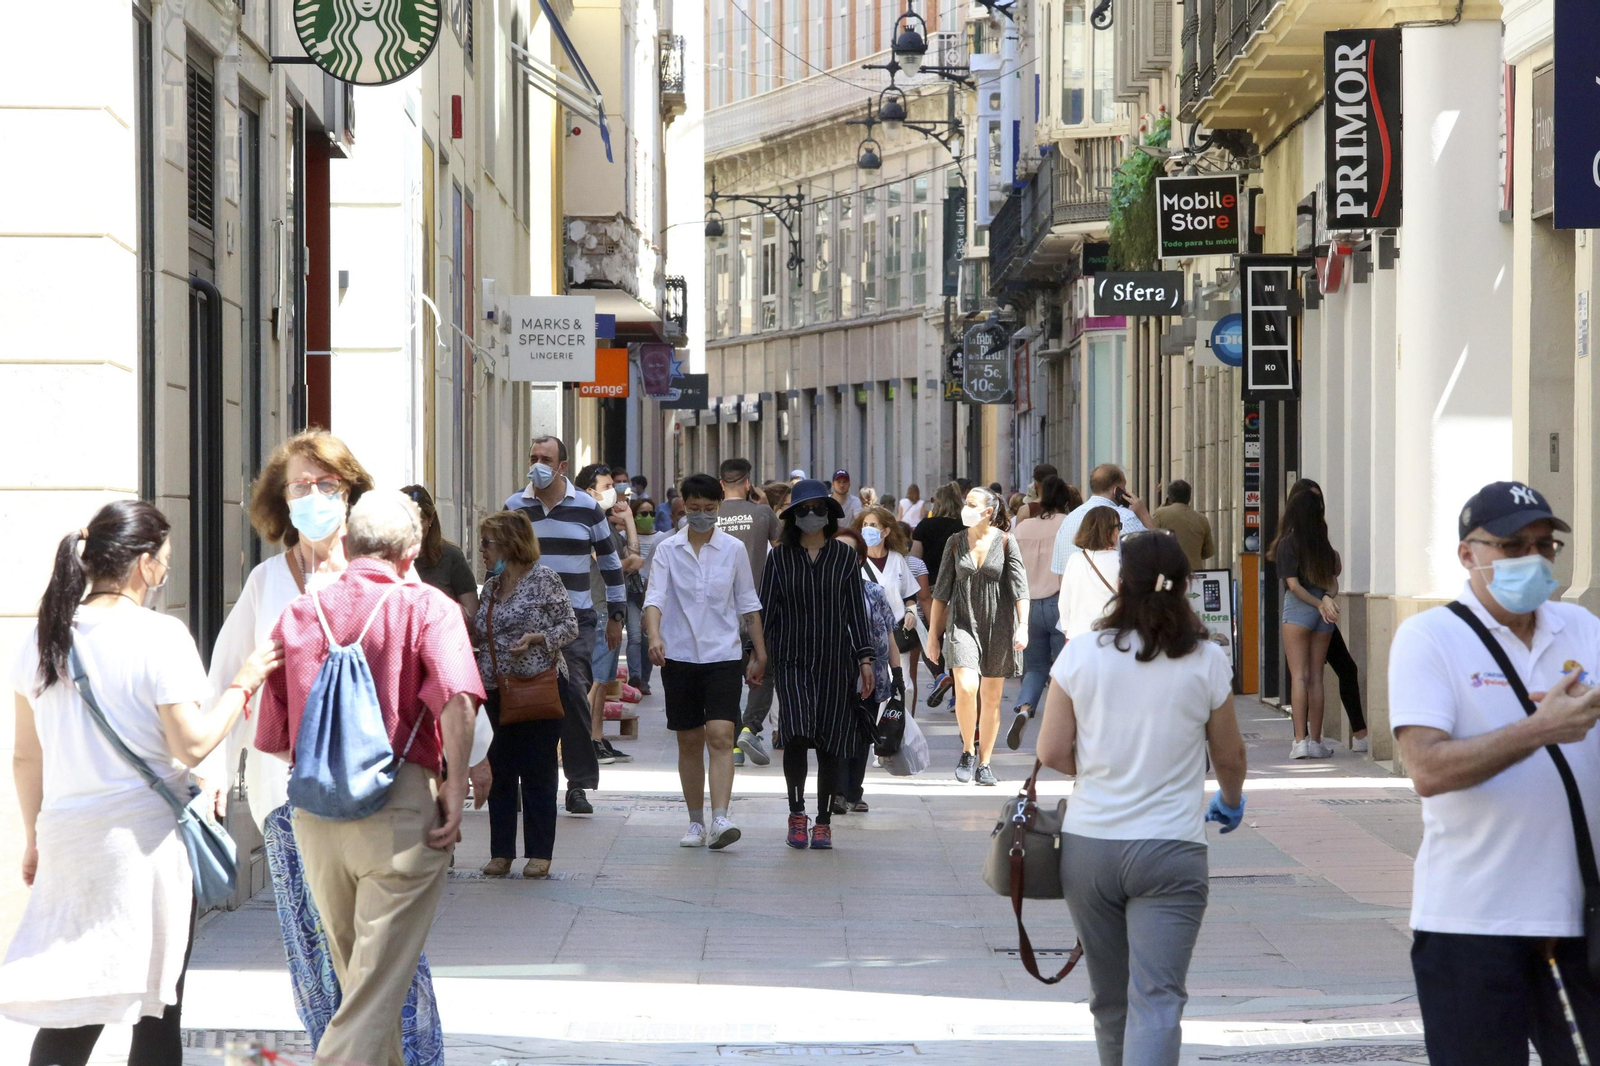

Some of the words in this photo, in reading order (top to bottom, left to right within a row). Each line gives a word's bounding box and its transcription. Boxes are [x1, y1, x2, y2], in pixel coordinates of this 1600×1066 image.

[1334, 40, 1368, 218] PRIMOR
[1163, 191, 1235, 211] Mobile
[1171, 213, 1230, 231] Store
[957, 224, 965, 236] del
[954, 238, 964, 261] Casa
[1185, 240, 1203, 248] para
[1113, 281, 1166, 302] Sfera
[521, 318, 570, 330] MARKS
[573, 318, 583, 330] &
[518, 334, 586, 346] SPENCER
[530, 352, 574, 360] LINGERIE
[581, 385, 624, 396] orange
[1202, 613, 1229, 622] Hora
